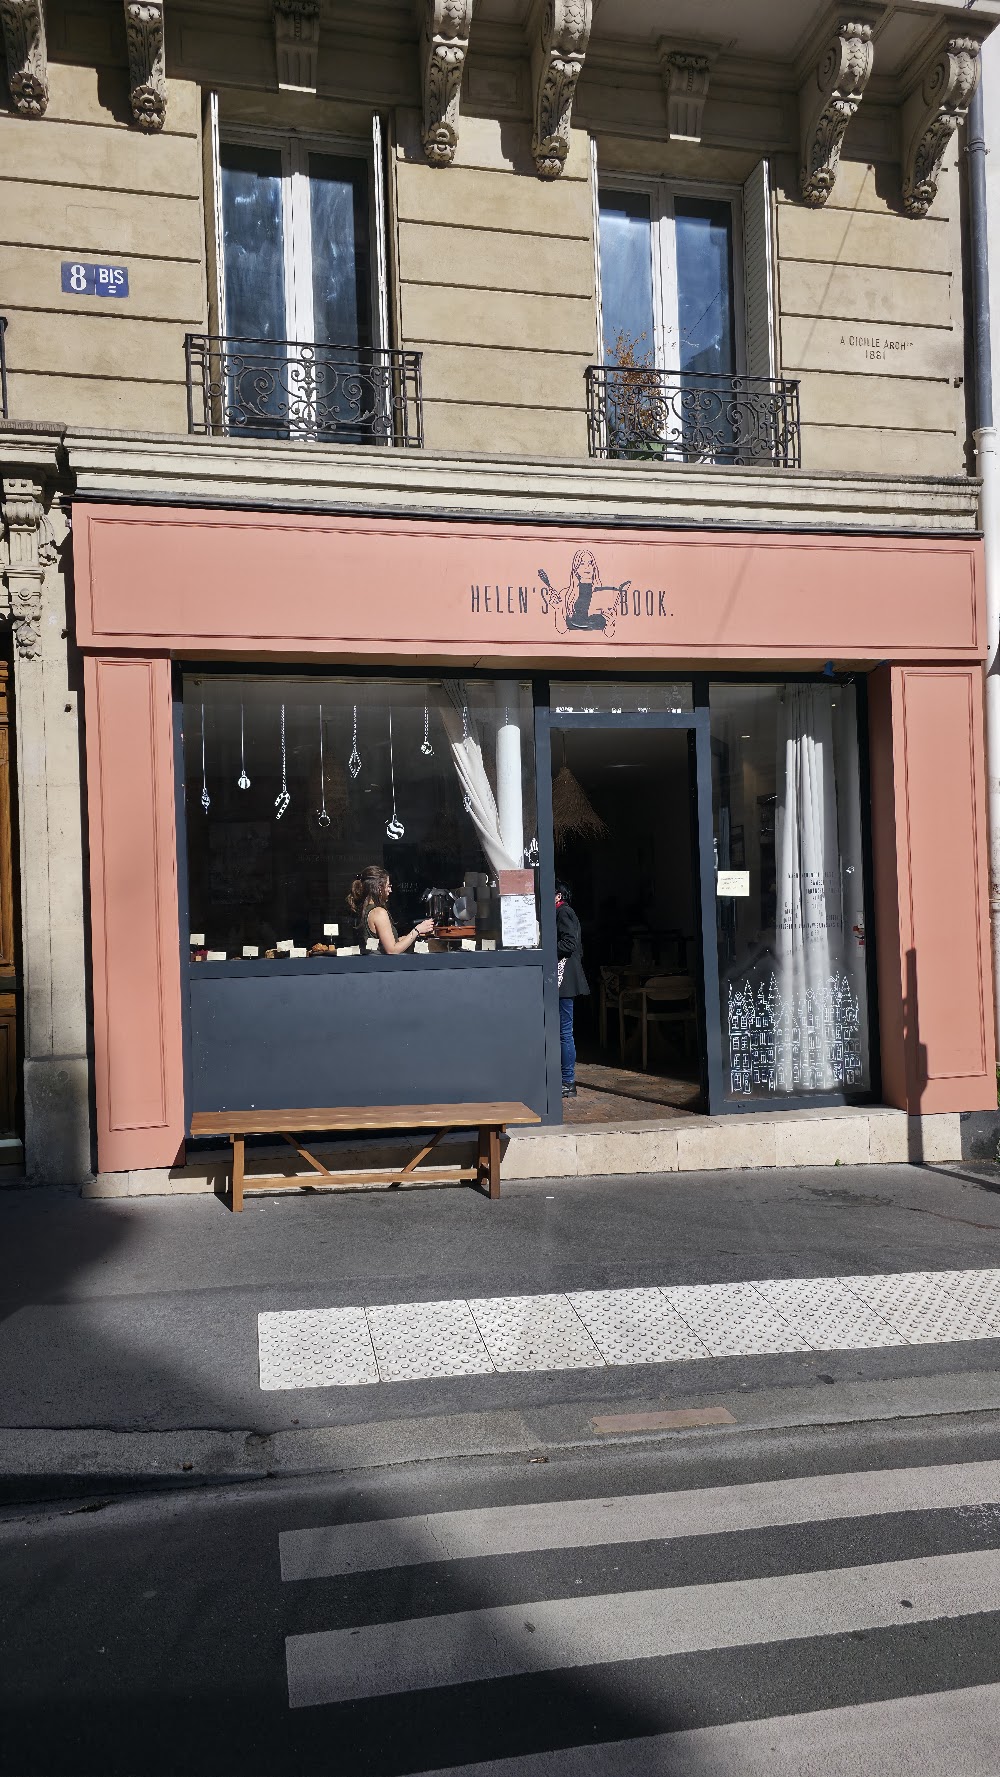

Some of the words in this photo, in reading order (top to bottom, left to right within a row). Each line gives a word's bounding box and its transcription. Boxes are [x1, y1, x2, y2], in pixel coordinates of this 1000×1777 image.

[70, 265, 87, 290] 8
[99, 268, 124, 284] BIS
[865, 350, 886, 360] 1881
[471, 584, 549, 615] HELEN'S
[619, 589, 674, 617] BOOK.
